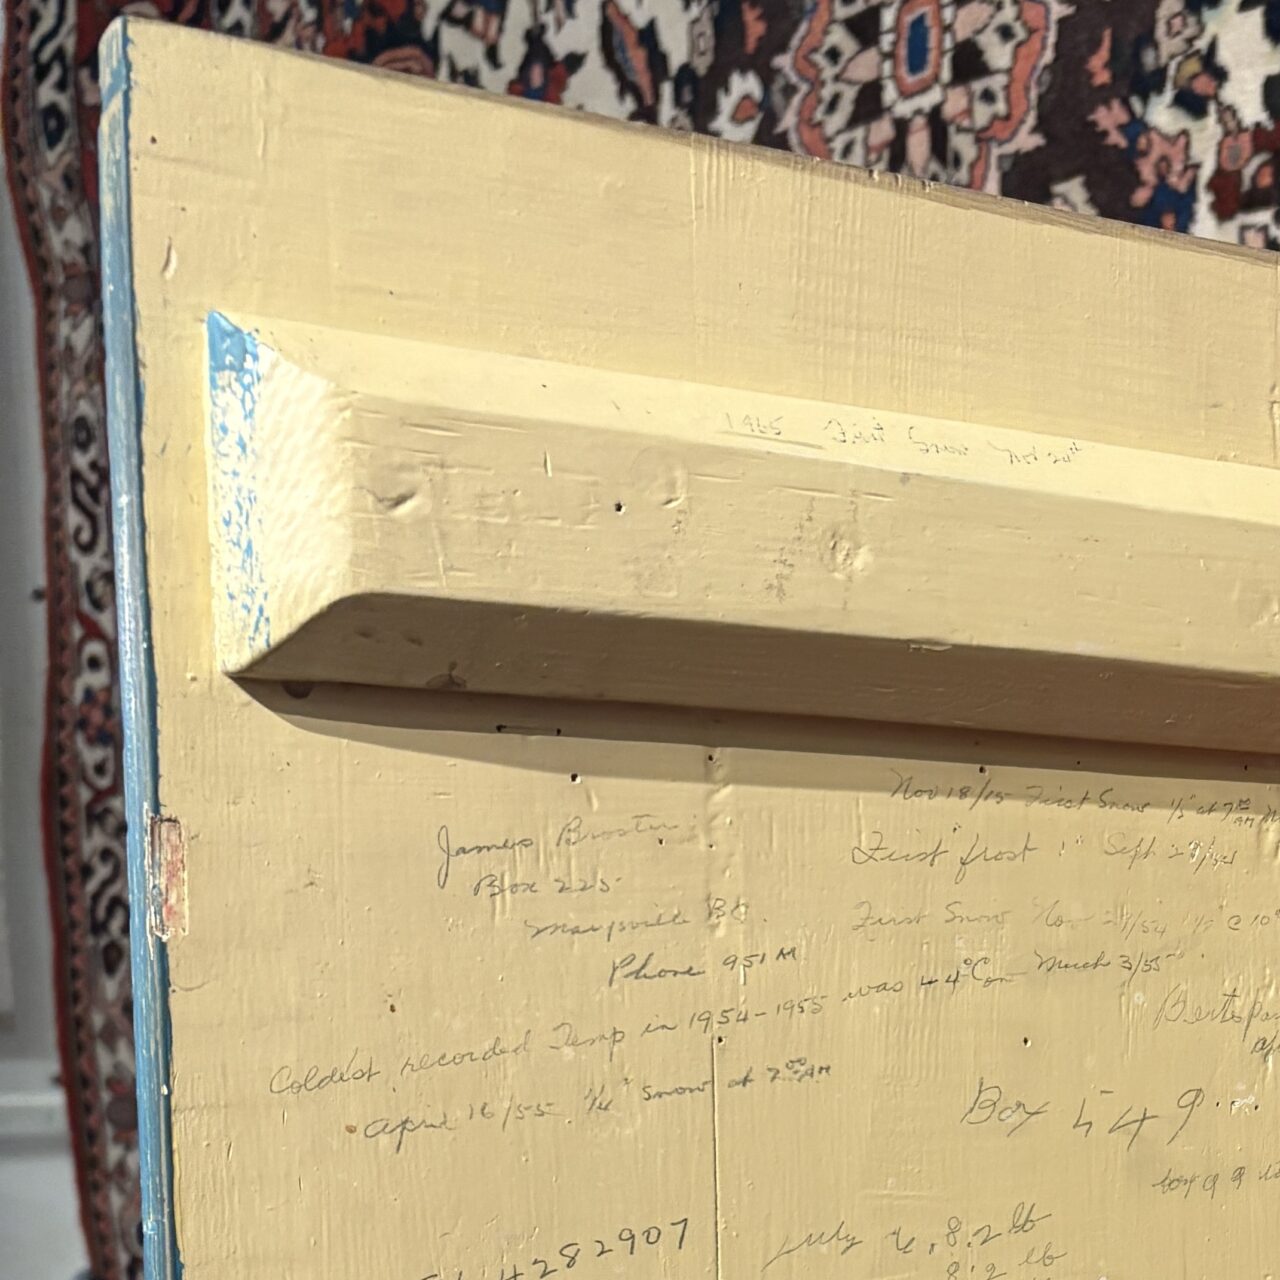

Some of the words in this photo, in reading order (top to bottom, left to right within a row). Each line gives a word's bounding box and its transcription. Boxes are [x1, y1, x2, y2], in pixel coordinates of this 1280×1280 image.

[608, 951, 706, 988] Phone
[269, 1047, 381, 1095] Coldest
[399, 1029, 532, 1077] recorded
[549, 1021, 626, 1063] Temp
[640, 1014, 678, 1039] in
[842, 980, 905, 1002] was
[961, 1076, 1048, 1137] Box
